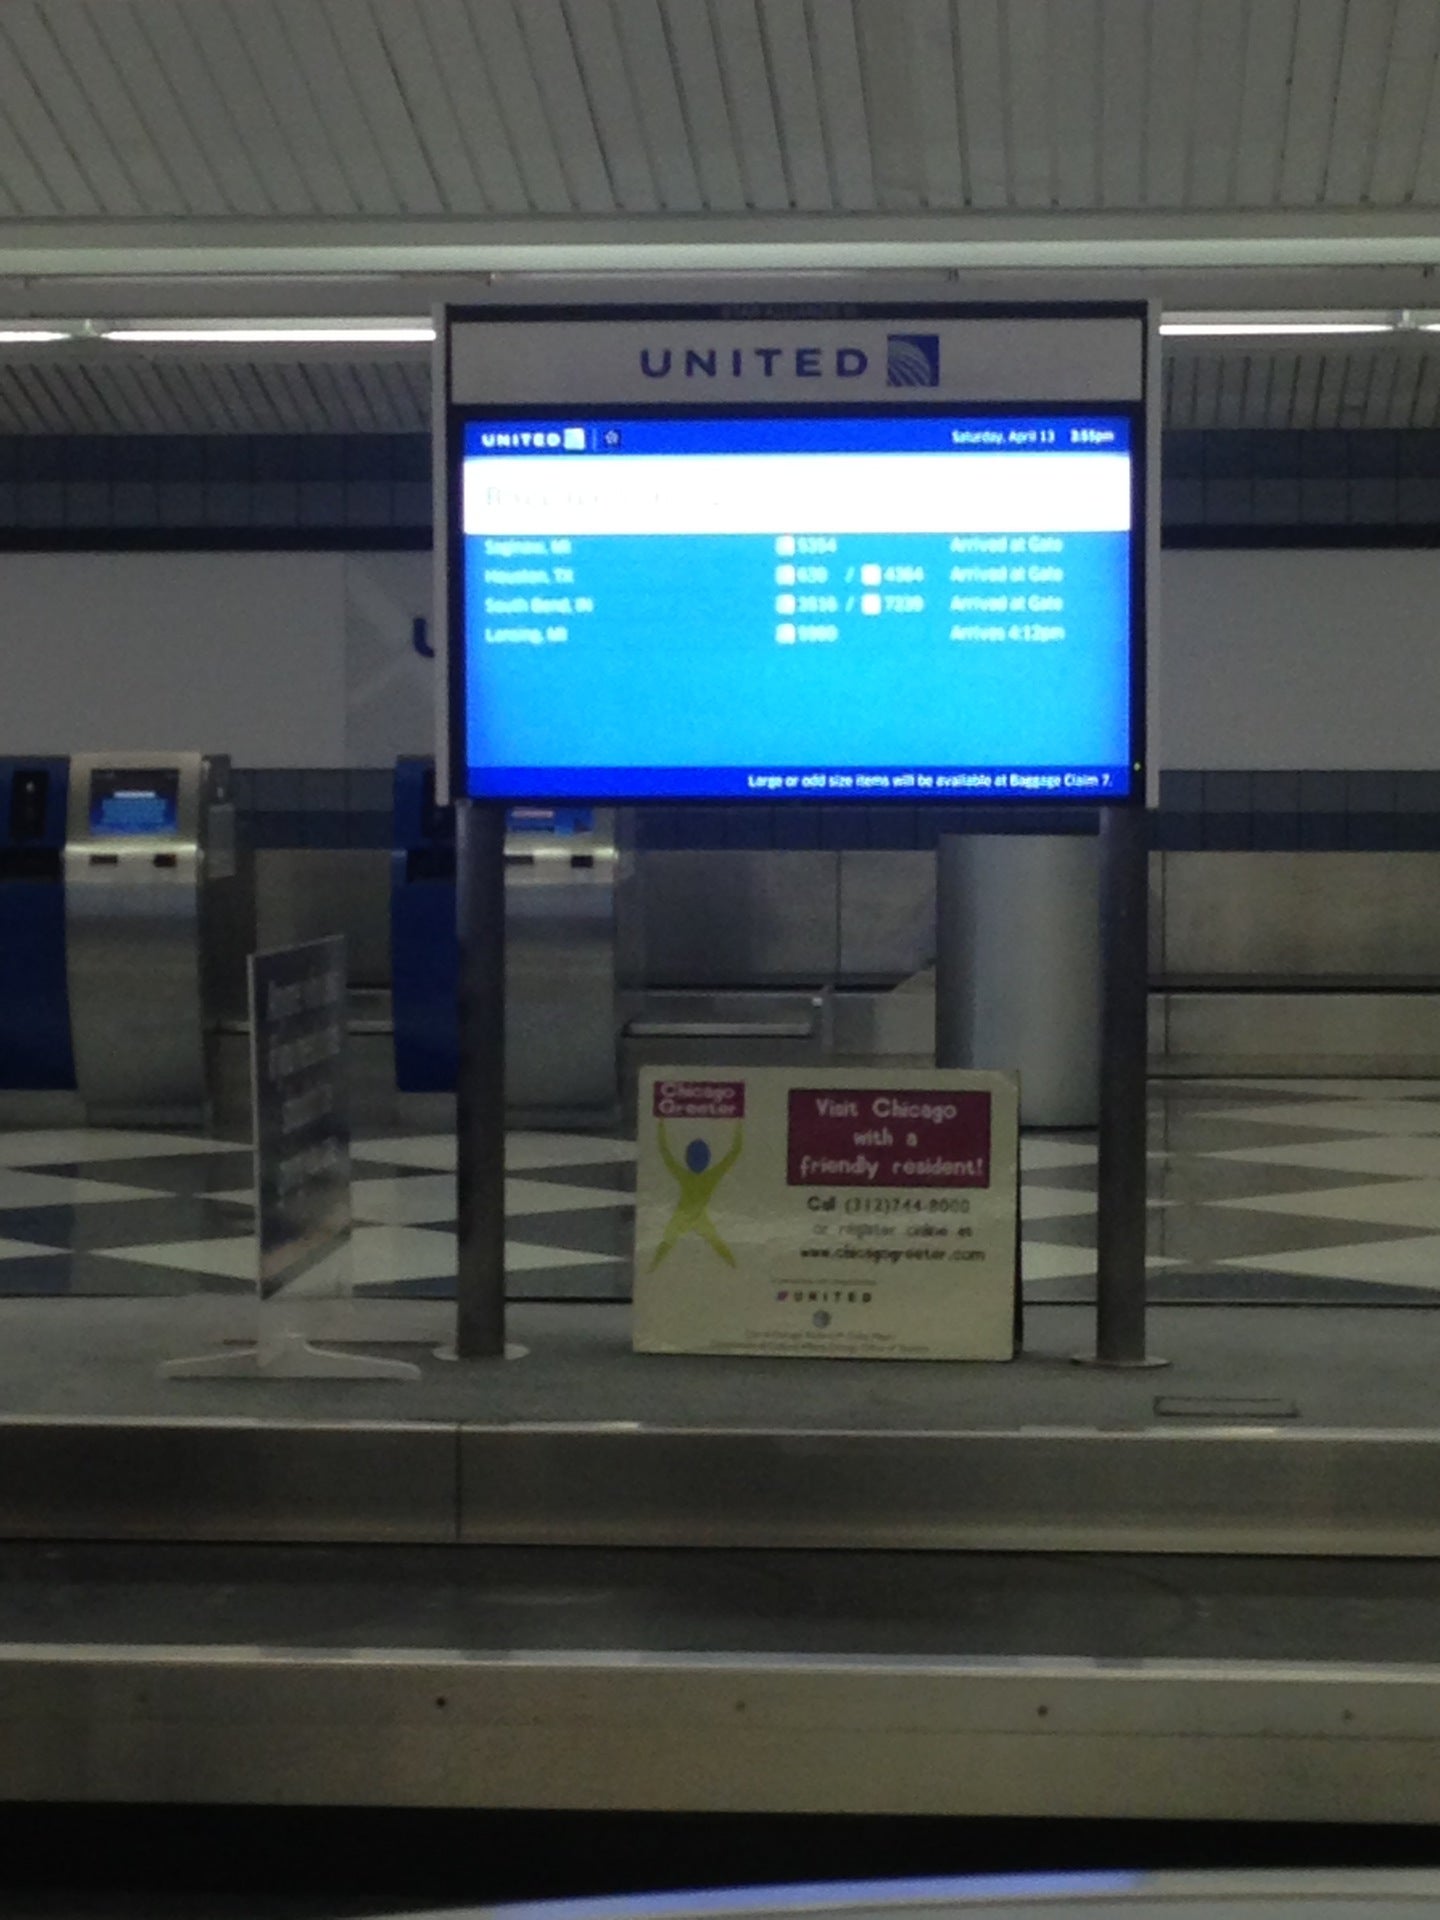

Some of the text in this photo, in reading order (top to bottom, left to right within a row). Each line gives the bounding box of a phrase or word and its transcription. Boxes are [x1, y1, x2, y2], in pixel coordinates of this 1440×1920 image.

[640, 348, 868, 378] UNITED
[481, 433, 561, 447] UNITED
[1009, 537, 1026, 552] at
[1009, 566, 1026, 582] at
[1009, 596, 1026, 611] at
[748, 774, 782, 789] Large
[785, 776, 799, 787] or
[801, 774, 826, 787] odd
[829, 775, 853, 787] size
[892, 774, 914, 787] will
[917, 774, 933, 787] be
[994, 775, 1006, 787] at
[1010, 773, 1061, 789] Baggage
[1063, 773, 1099, 787] Claim
[660, 1083, 736, 1102] Chicago
[658, 1100, 737, 1115] Greeter
[816, 1097, 957, 1123] Visit Chicago
[853, 1127, 917, 1147] with a
[800, 1155, 984, 1180] friendly resident!
